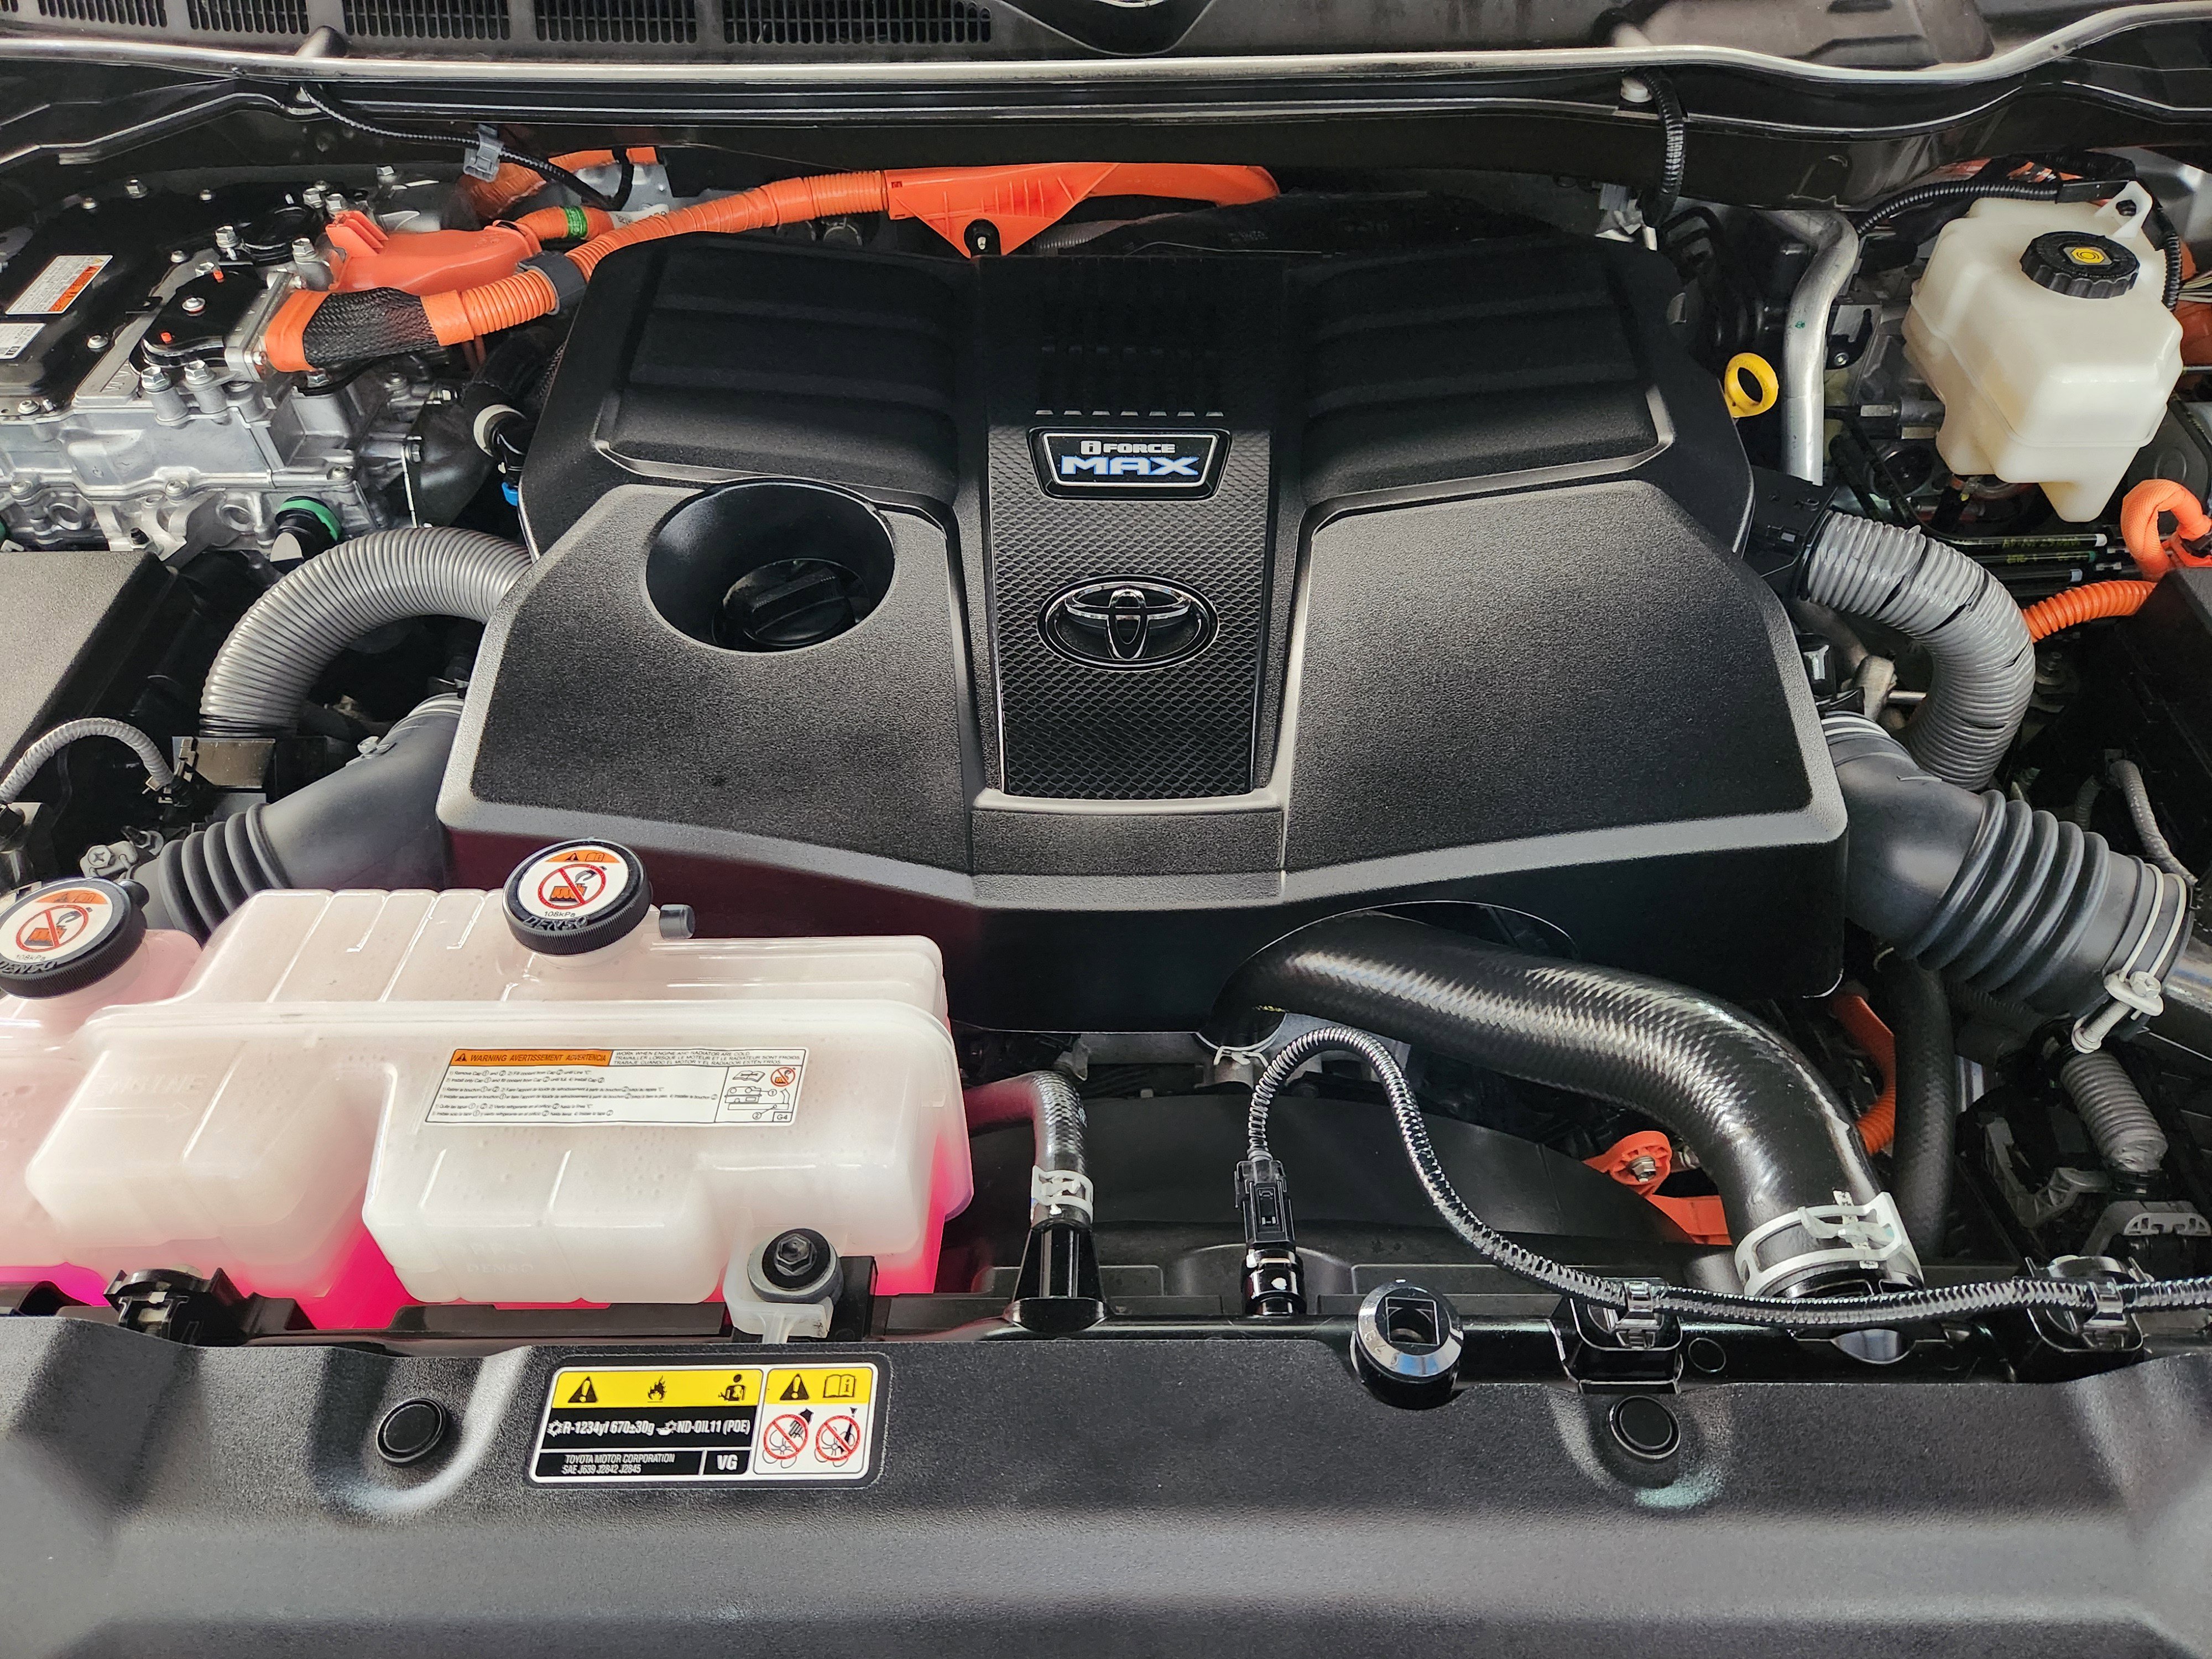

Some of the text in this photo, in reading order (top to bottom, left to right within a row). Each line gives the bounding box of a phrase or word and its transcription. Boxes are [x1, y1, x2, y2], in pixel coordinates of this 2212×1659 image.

[1103, 443, 1176, 453] FORCE
[1061, 455, 1200, 476] MAX
[523, 915, 589, 931] DENSO
[562, 1421, 610, 1437] R-1234yf
[609, 1420, 655, 1436] 670±30g
[722, 1419, 751, 1436] (POE)
[565, 1453, 675, 1464] TOYOTA MOTOR CORPORATION
[717, 1454, 738, 1470] VG
[561, 1464, 641, 1474] SAE J639 J2842 J2845
